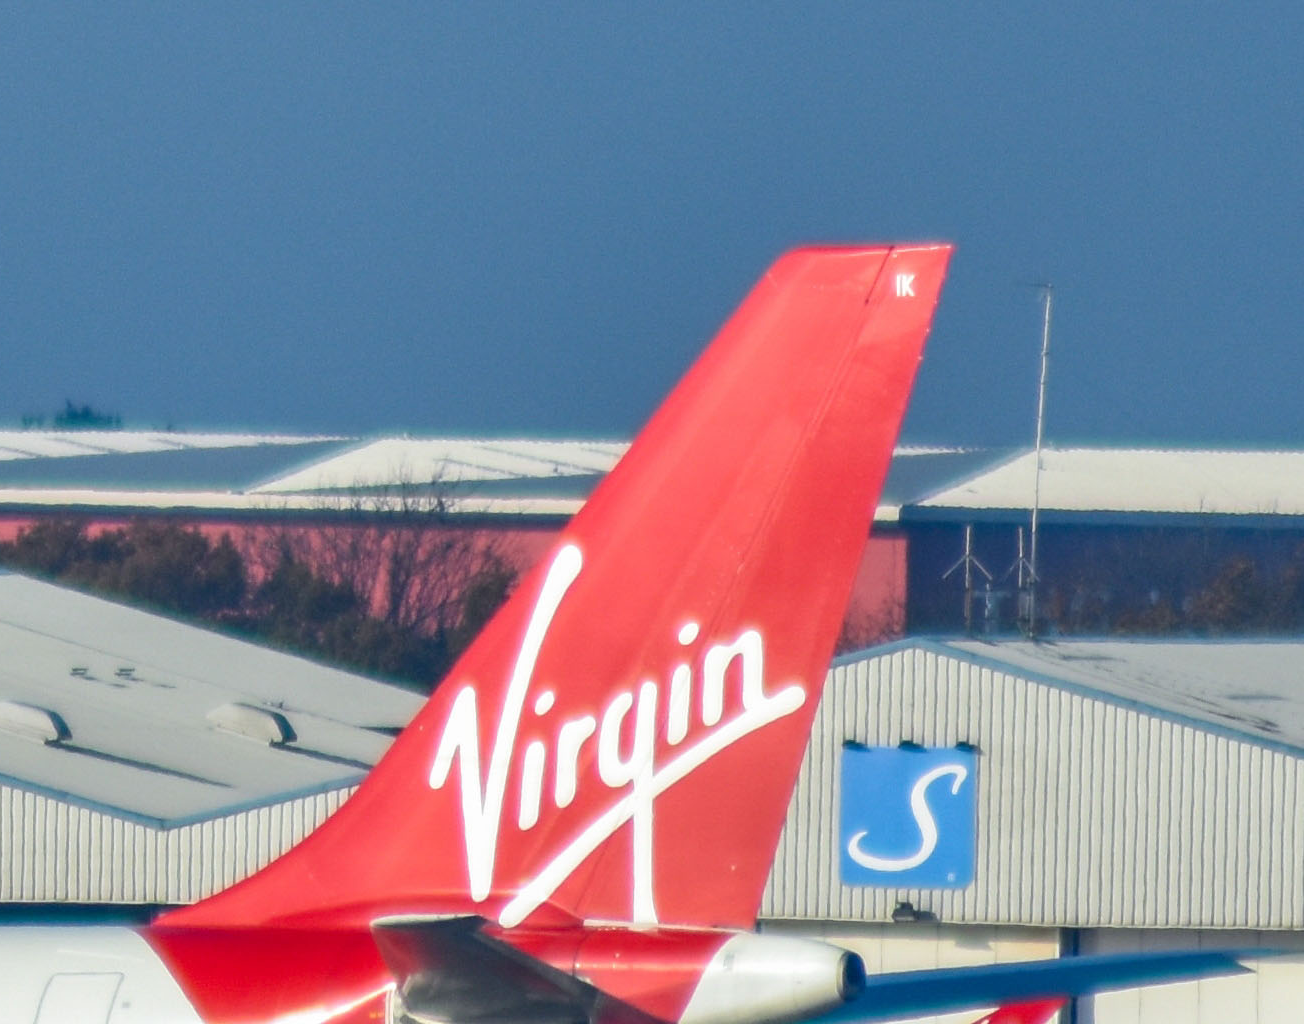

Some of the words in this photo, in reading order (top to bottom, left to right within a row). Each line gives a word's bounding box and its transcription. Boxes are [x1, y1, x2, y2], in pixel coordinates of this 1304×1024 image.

[896, 274, 916, 297] IK
[429, 544, 806, 928] Virgin
[848, 764, 967, 872] S
